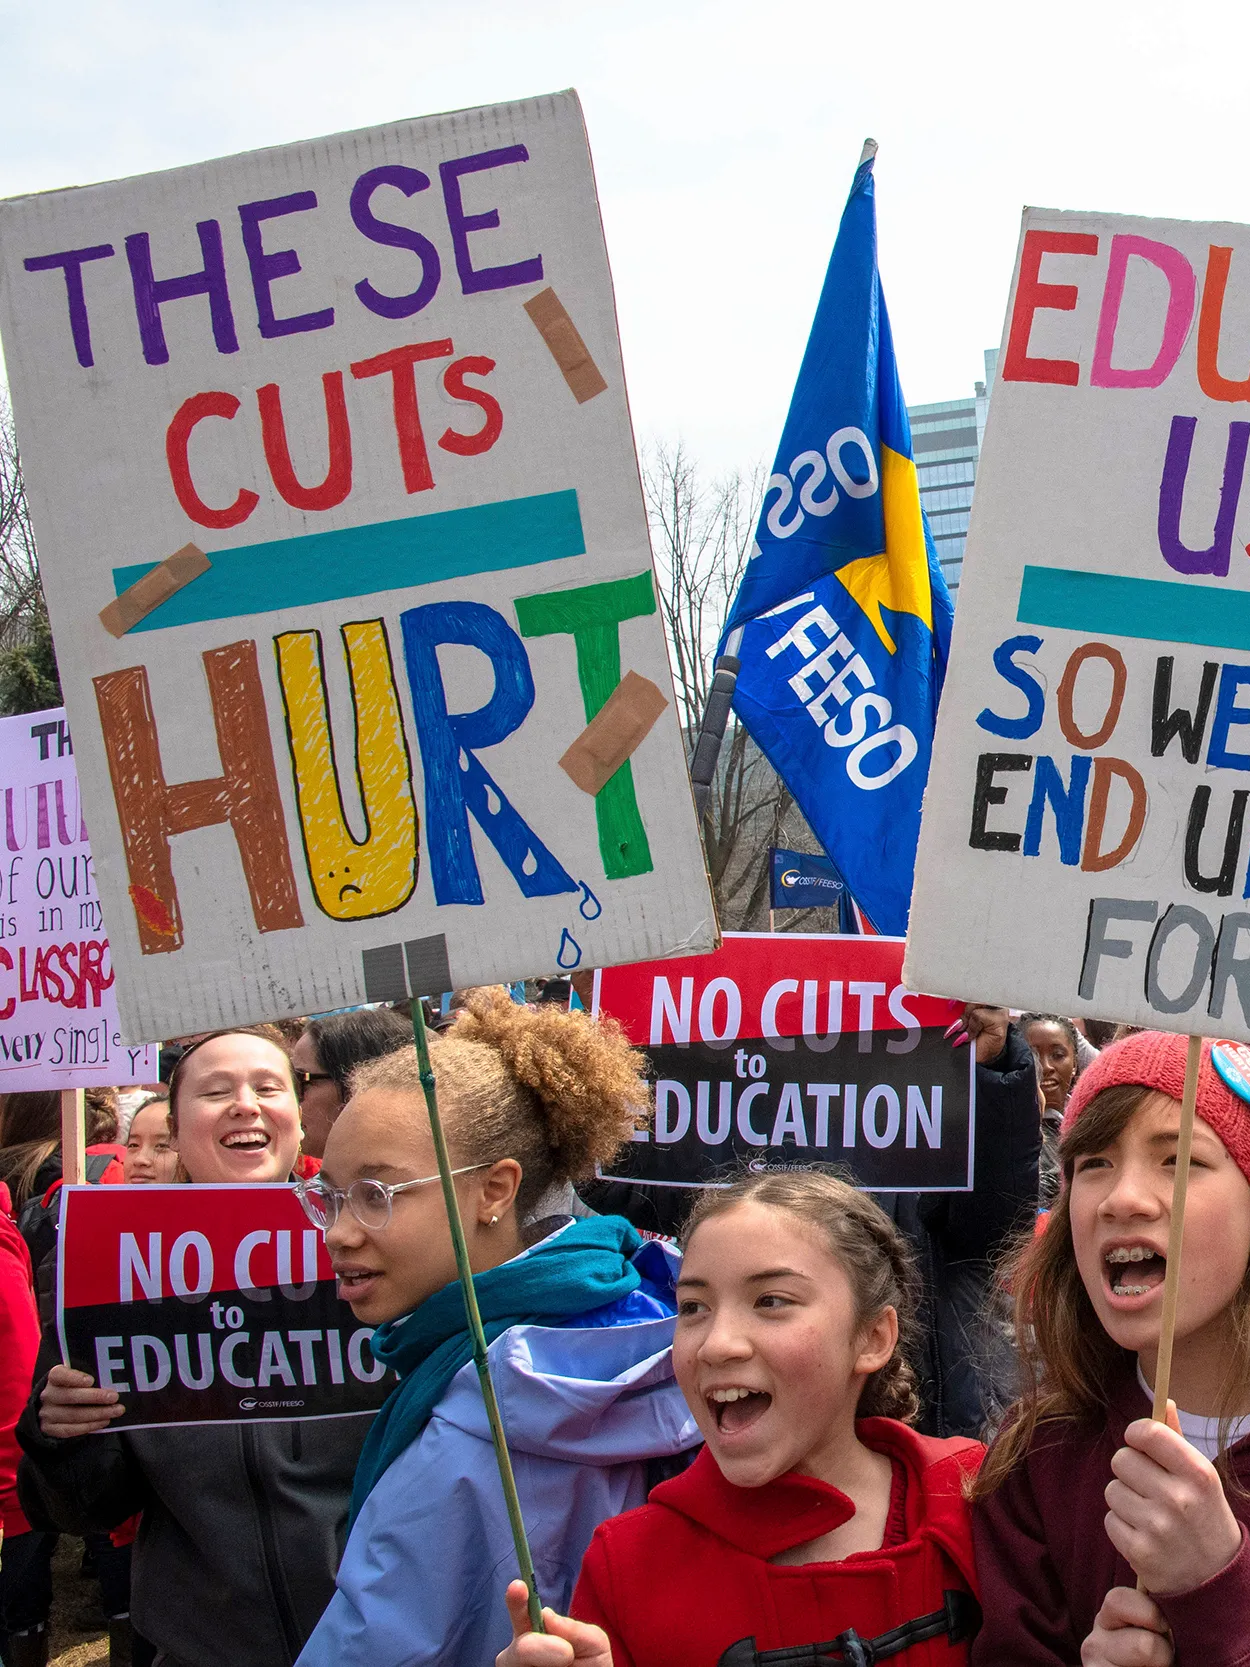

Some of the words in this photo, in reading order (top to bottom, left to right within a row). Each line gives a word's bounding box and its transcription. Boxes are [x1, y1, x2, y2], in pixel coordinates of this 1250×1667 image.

[23, 143, 544, 368] THESE
[165, 337, 503, 530] CUTS
[976, 634, 1127, 750] SO
[92, 569, 657, 955] HURT
[968, 753, 1147, 872] END
[38, 906, 63, 932] in
[650, 976, 742, 1050] NO
[760, 978, 922, 1055] CUTS
[734, 1049, 767, 1079] to
[1221, 1043, 1250, 1072] HURT
[119, 1230, 214, 1305] NO
[234, 1229, 332, 1303] CU
[210, 1301, 245, 1330] to
[94, 1328, 403, 1394] EDUCATIO
[258, 1400, 305, 1408] OSSTF/FEESO
